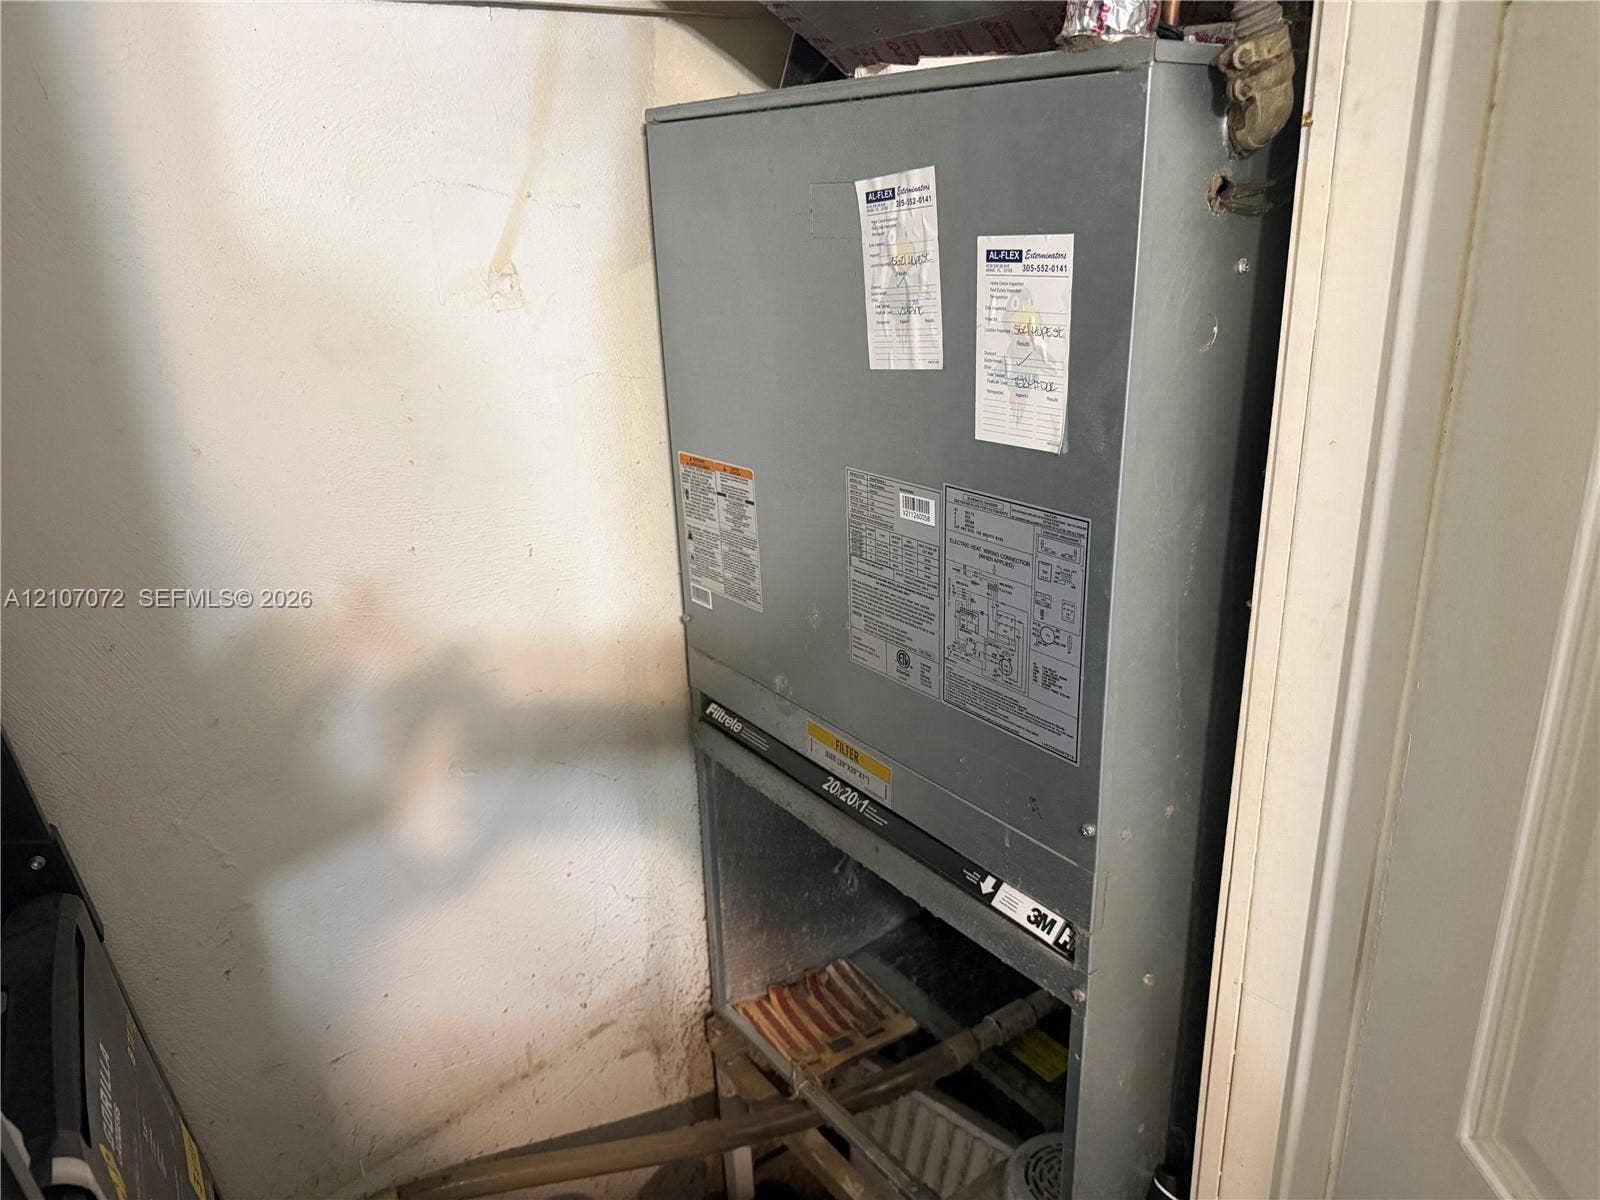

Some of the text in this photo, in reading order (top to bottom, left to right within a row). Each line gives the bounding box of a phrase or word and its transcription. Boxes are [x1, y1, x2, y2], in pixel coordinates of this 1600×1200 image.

[868, 184, 930, 200] AL-FLEX Exterminators
[896, 195, 932, 207] 305-552-0141
[989, 249, 1067, 260] AL-FLEX Exterminators
[1022, 264, 1067, 273] 305-552-0141
[949, 537, 1031, 568] ELECTRIC HEAT WIRING CONNECTION
[705, 702, 743, 734] Filtrete
[835, 739, 861, 764] FILTER
[821, 776, 870, 814] 20x20x1
[1026, 907, 1058, 936] 3M
[99, 1041, 116, 1151] GORILLA
